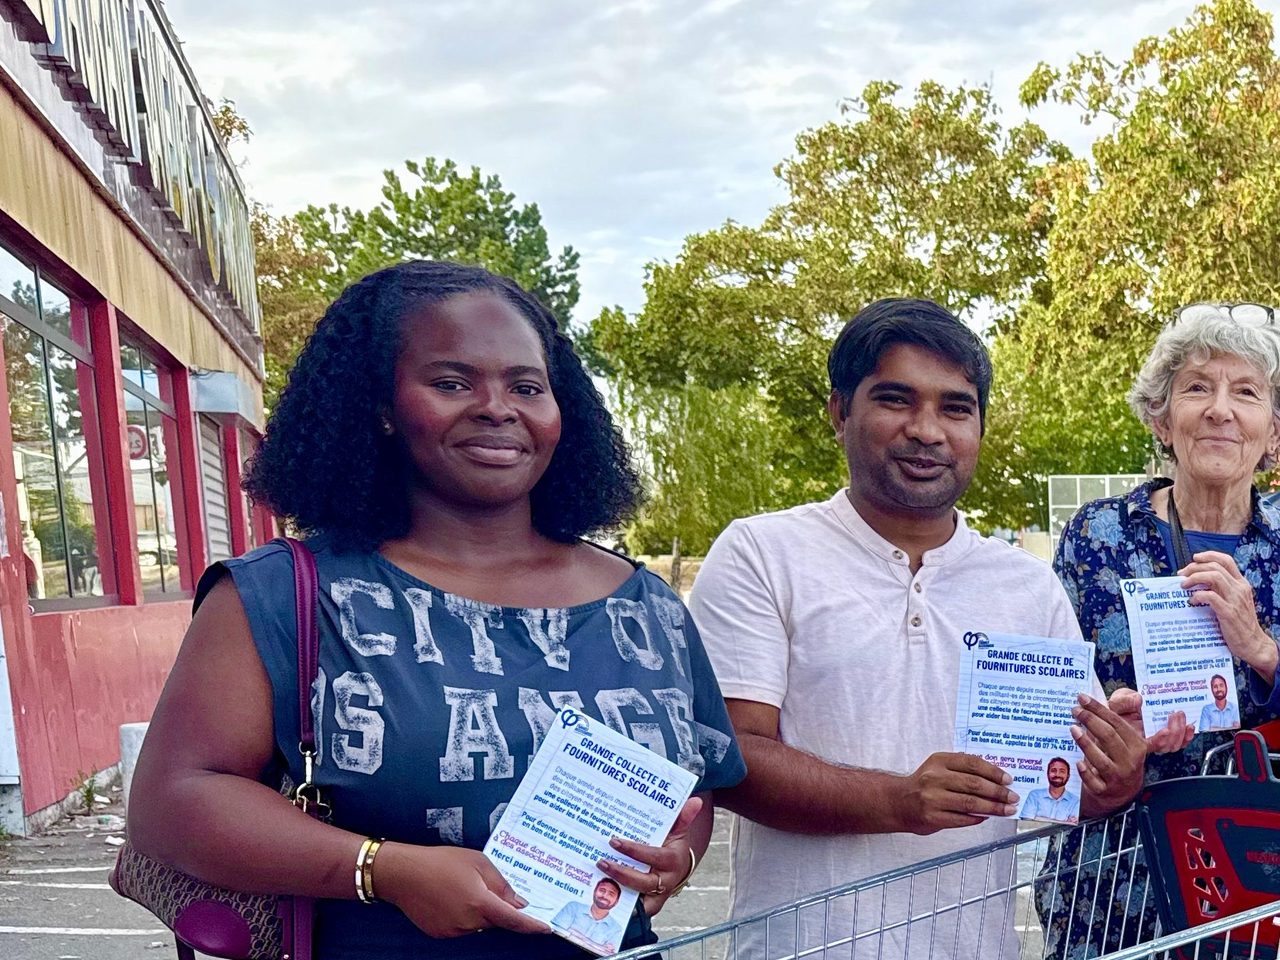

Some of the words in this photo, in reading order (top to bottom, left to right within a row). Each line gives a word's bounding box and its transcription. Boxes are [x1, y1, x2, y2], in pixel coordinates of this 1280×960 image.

[1139, 599, 1185, 612] FOURNITURES
[1145, 591, 1170, 601] GRANDE
[330, 577, 570, 676] CITY
[976, 659, 1036, 675] FOURNITURES
[1038, 666, 1085, 680] SCOLAIRES
[987, 649, 1020, 661] GRANDE
[1021, 652, 1062, 665] COLLECTE
[1063, 656, 1074, 666] DE
[561, 742, 628, 783] FOURNITURES
[625, 775, 677, 810] SCOLAIRES
[578, 736, 616, 762] GRANDE
[613, 755, 658, 785] COLLECTE
[657, 778, 671, 792] DE
[489, 847, 515, 864] Merci
[512, 859, 532, 873] pour
[531, 868, 555, 884] votre
[552, 879, 580, 895] action
[492, 833, 500, 842] à
[499, 837, 516, 850] des
[513, 845, 565, 872] associations
[563, 868, 594, 886] locales.
[496, 829, 530, 849] Chaque
[528, 844, 547, 857] don
[546, 853, 565, 866] sera
[563, 861, 594, 879] reversé
